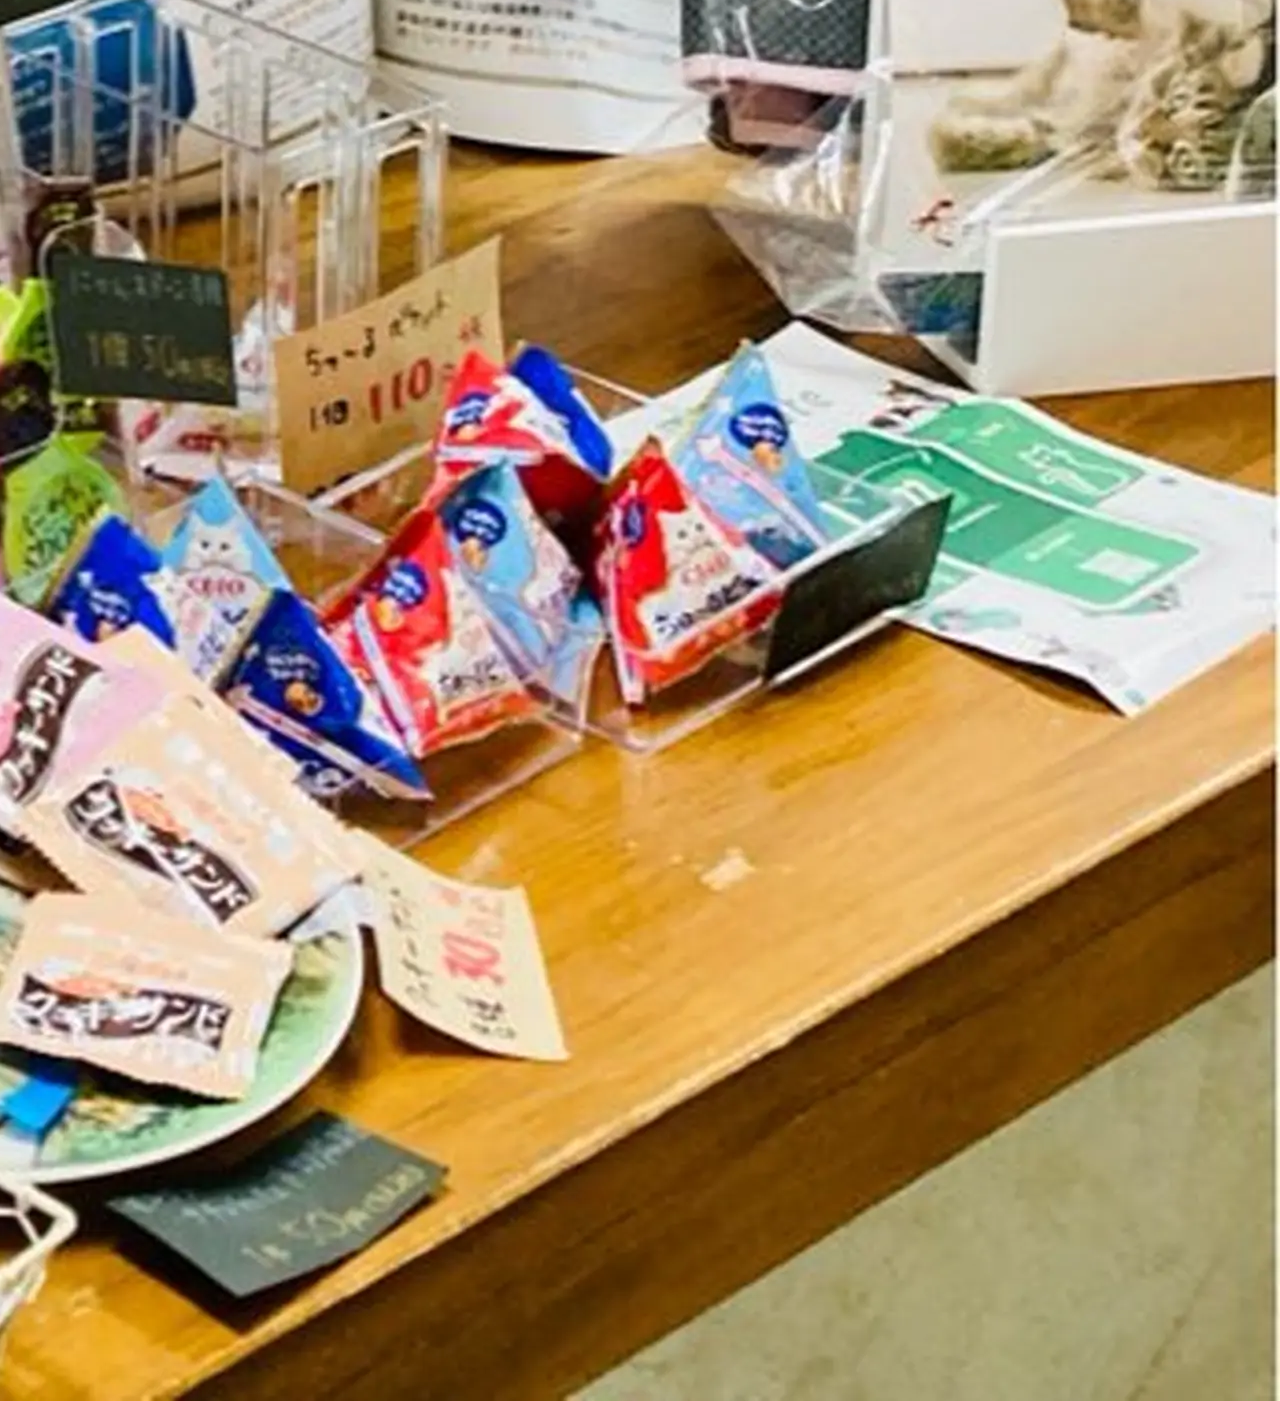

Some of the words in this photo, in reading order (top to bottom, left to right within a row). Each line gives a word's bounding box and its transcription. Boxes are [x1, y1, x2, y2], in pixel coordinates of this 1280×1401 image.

[71, 788, 252, 920] クッキーサンド
[16, 988, 228, 1052] クッキーサンド
